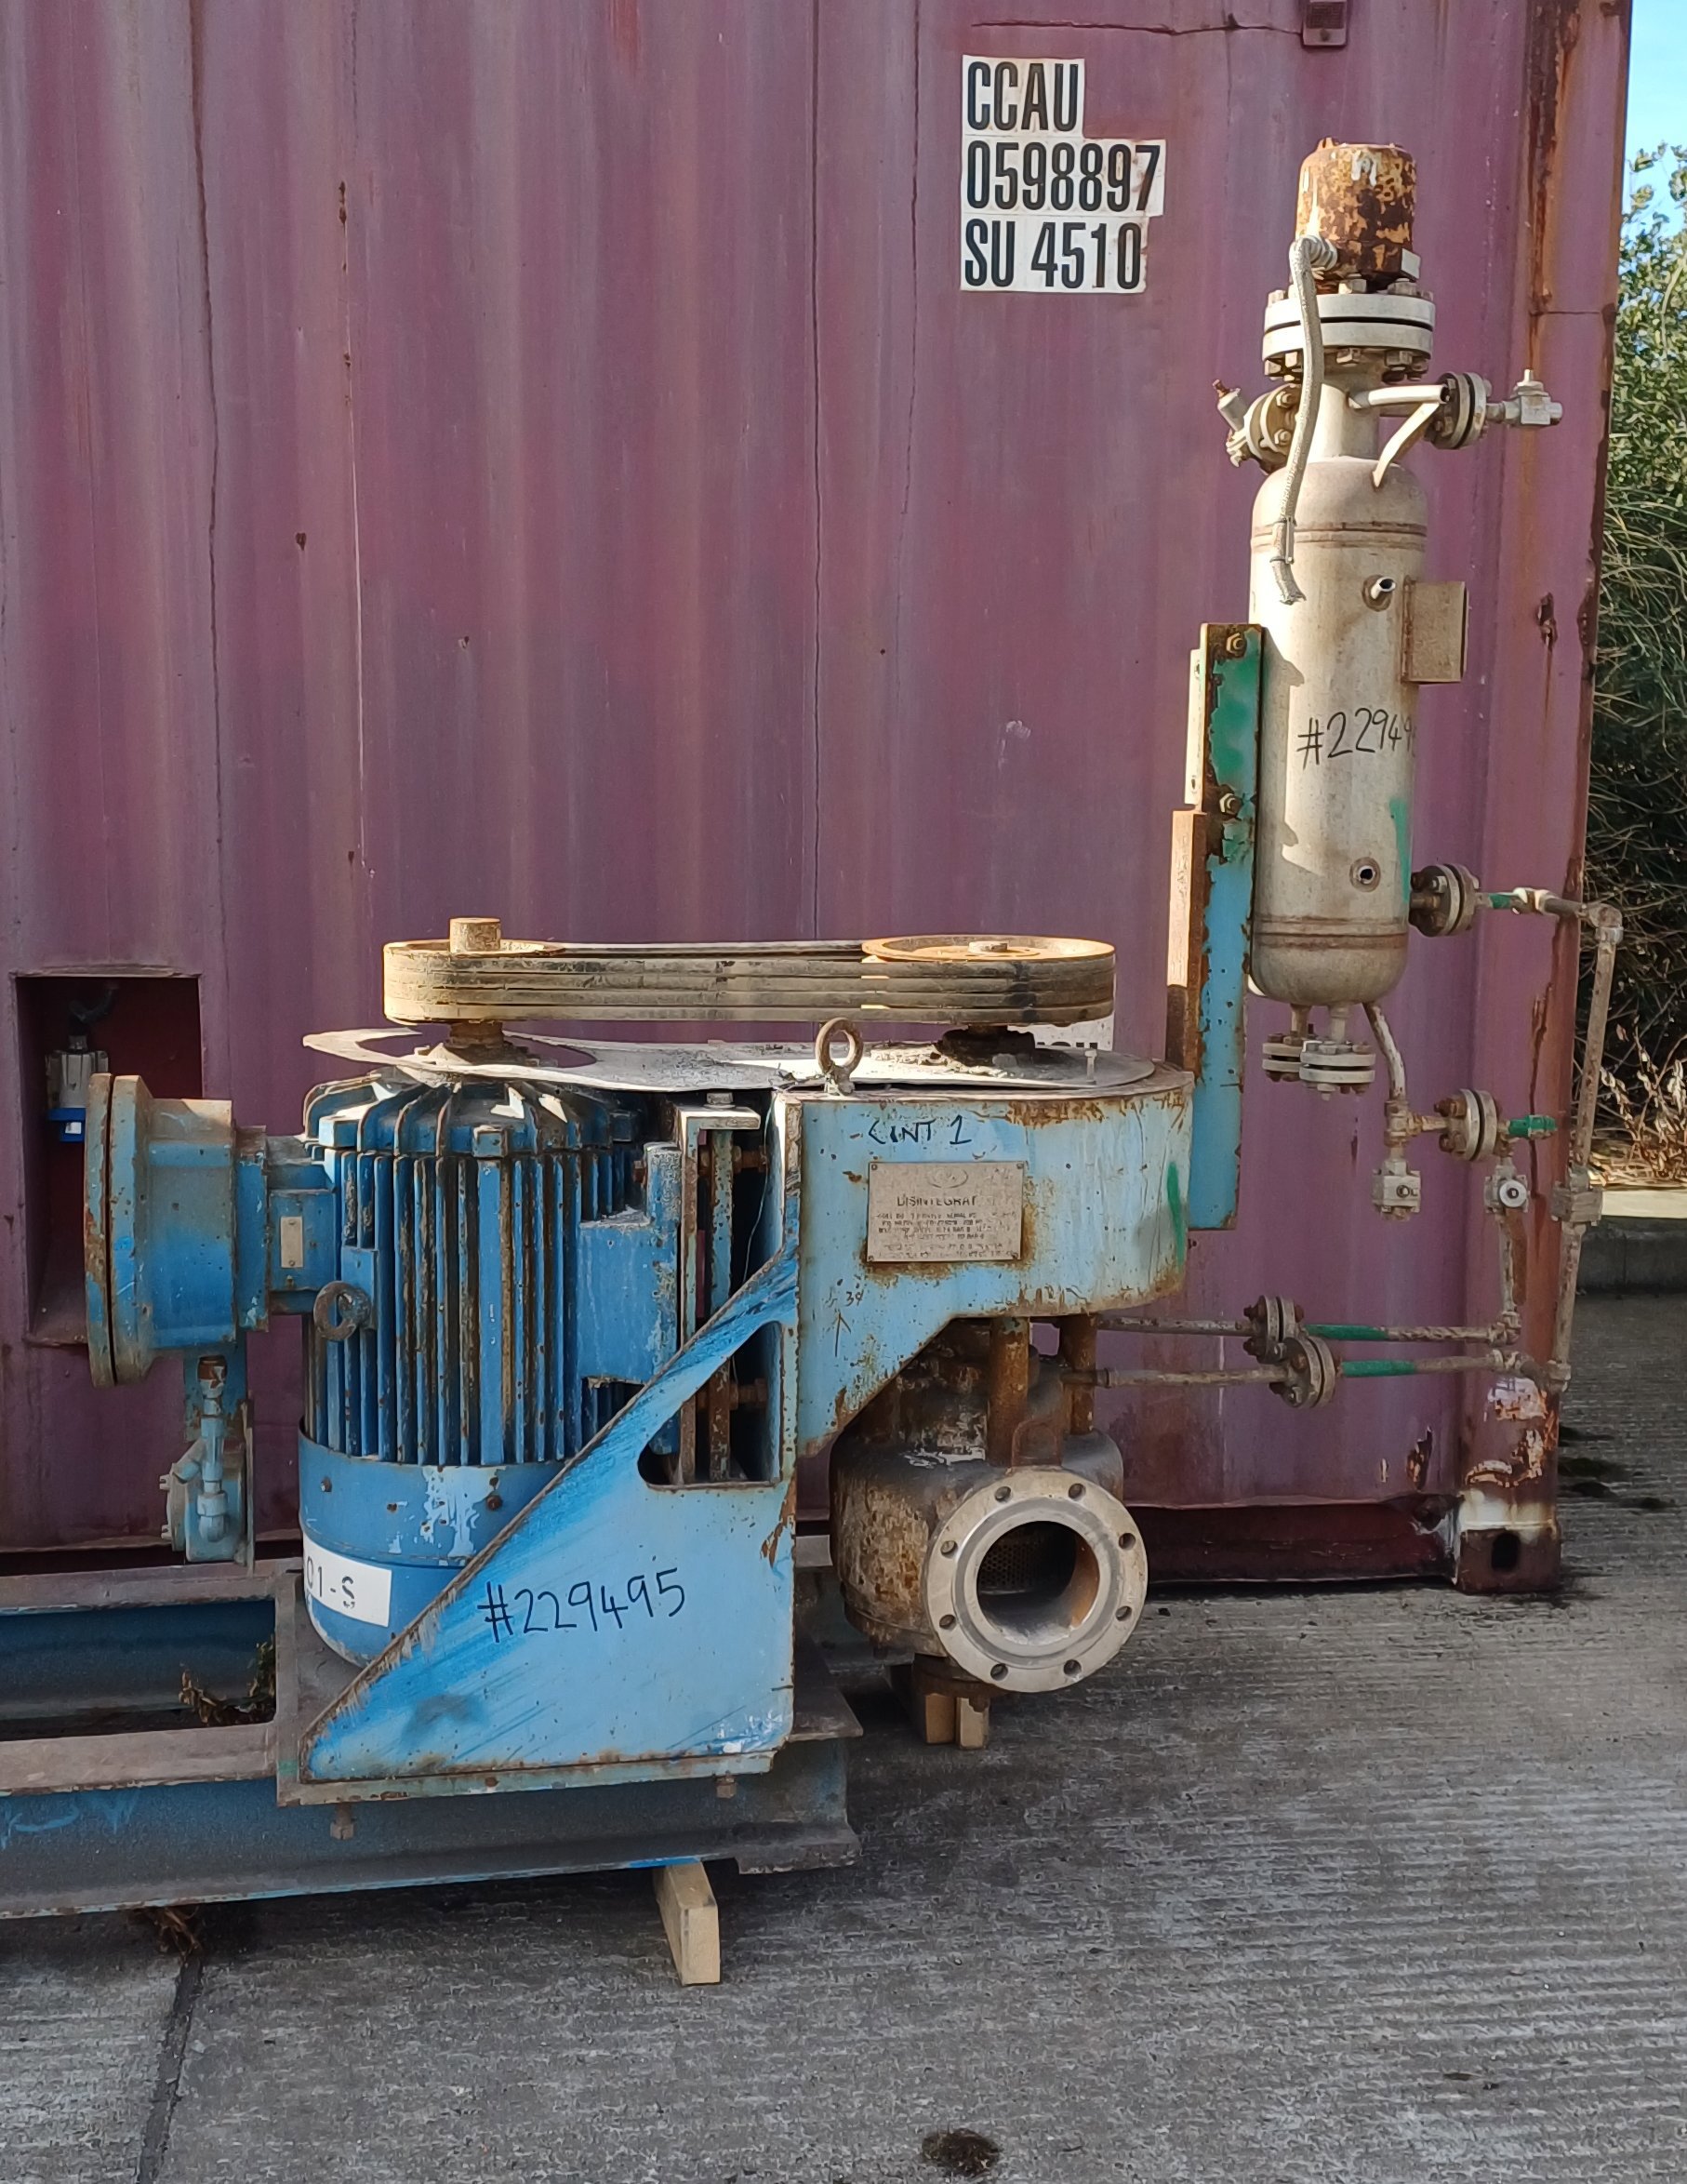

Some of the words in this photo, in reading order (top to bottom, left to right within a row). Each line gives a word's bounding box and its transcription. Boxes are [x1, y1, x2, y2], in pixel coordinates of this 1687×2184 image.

[967, 61, 1079, 132] CCAU
[967, 140, 1161, 212] 0598897
[964, 218, 1016, 287] SU
[1030, 221, 1142, 289] 4510
[477, 1566, 685, 1644] #229495
